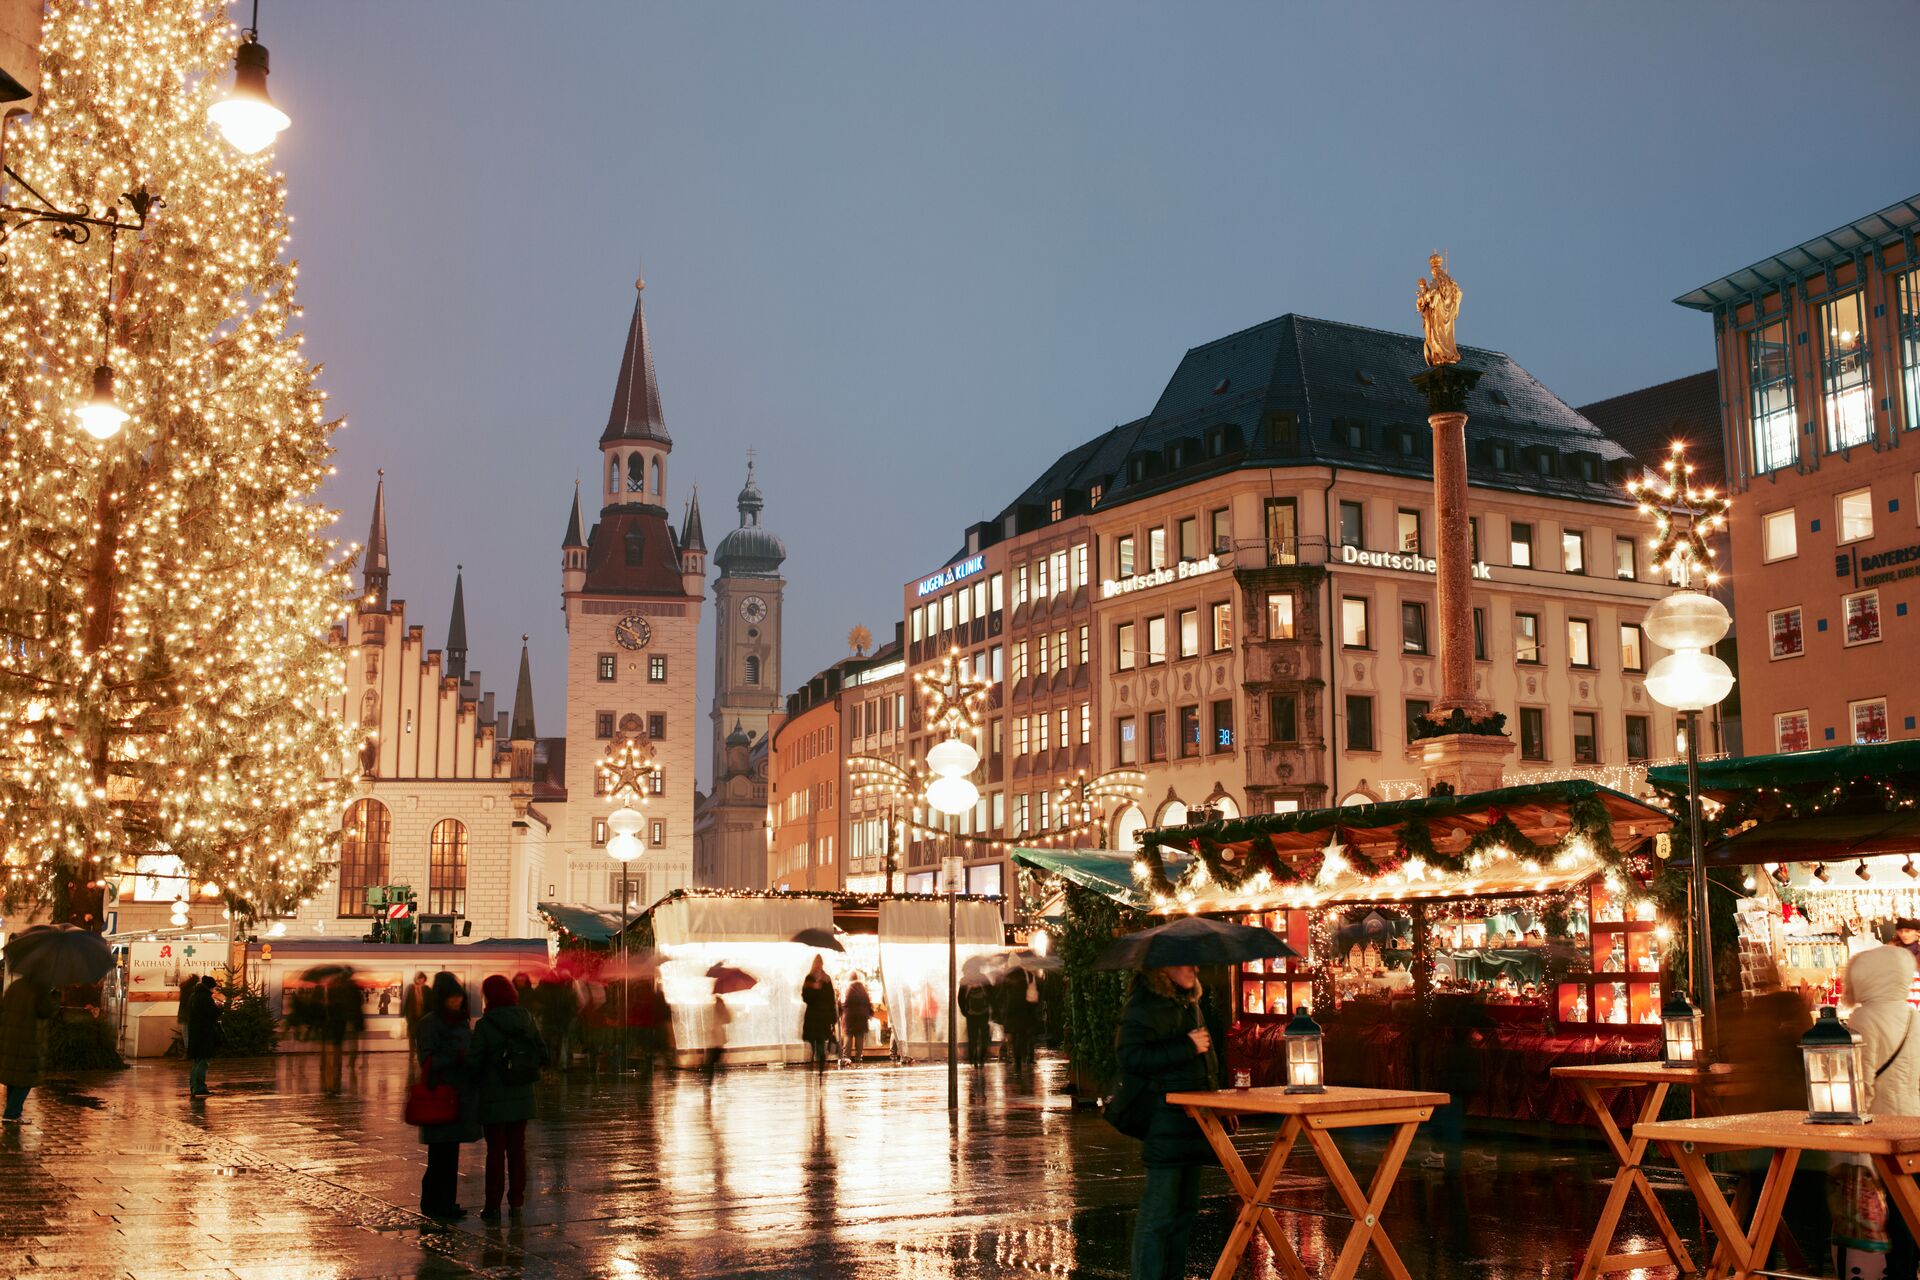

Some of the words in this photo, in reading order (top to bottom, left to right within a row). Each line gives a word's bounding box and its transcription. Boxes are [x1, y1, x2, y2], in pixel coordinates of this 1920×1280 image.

[918, 573, 945, 597] AUGEN
[954, 555, 984, 580] KLINIK
[1103, 566, 1176, 598] Deutsche
[1178, 554, 1220, 579] Bank
[1342, 545, 1437, 573] Deutsche
[1471, 560, 1491, 579] nk
[134, 959, 172, 967] RATHAUS
